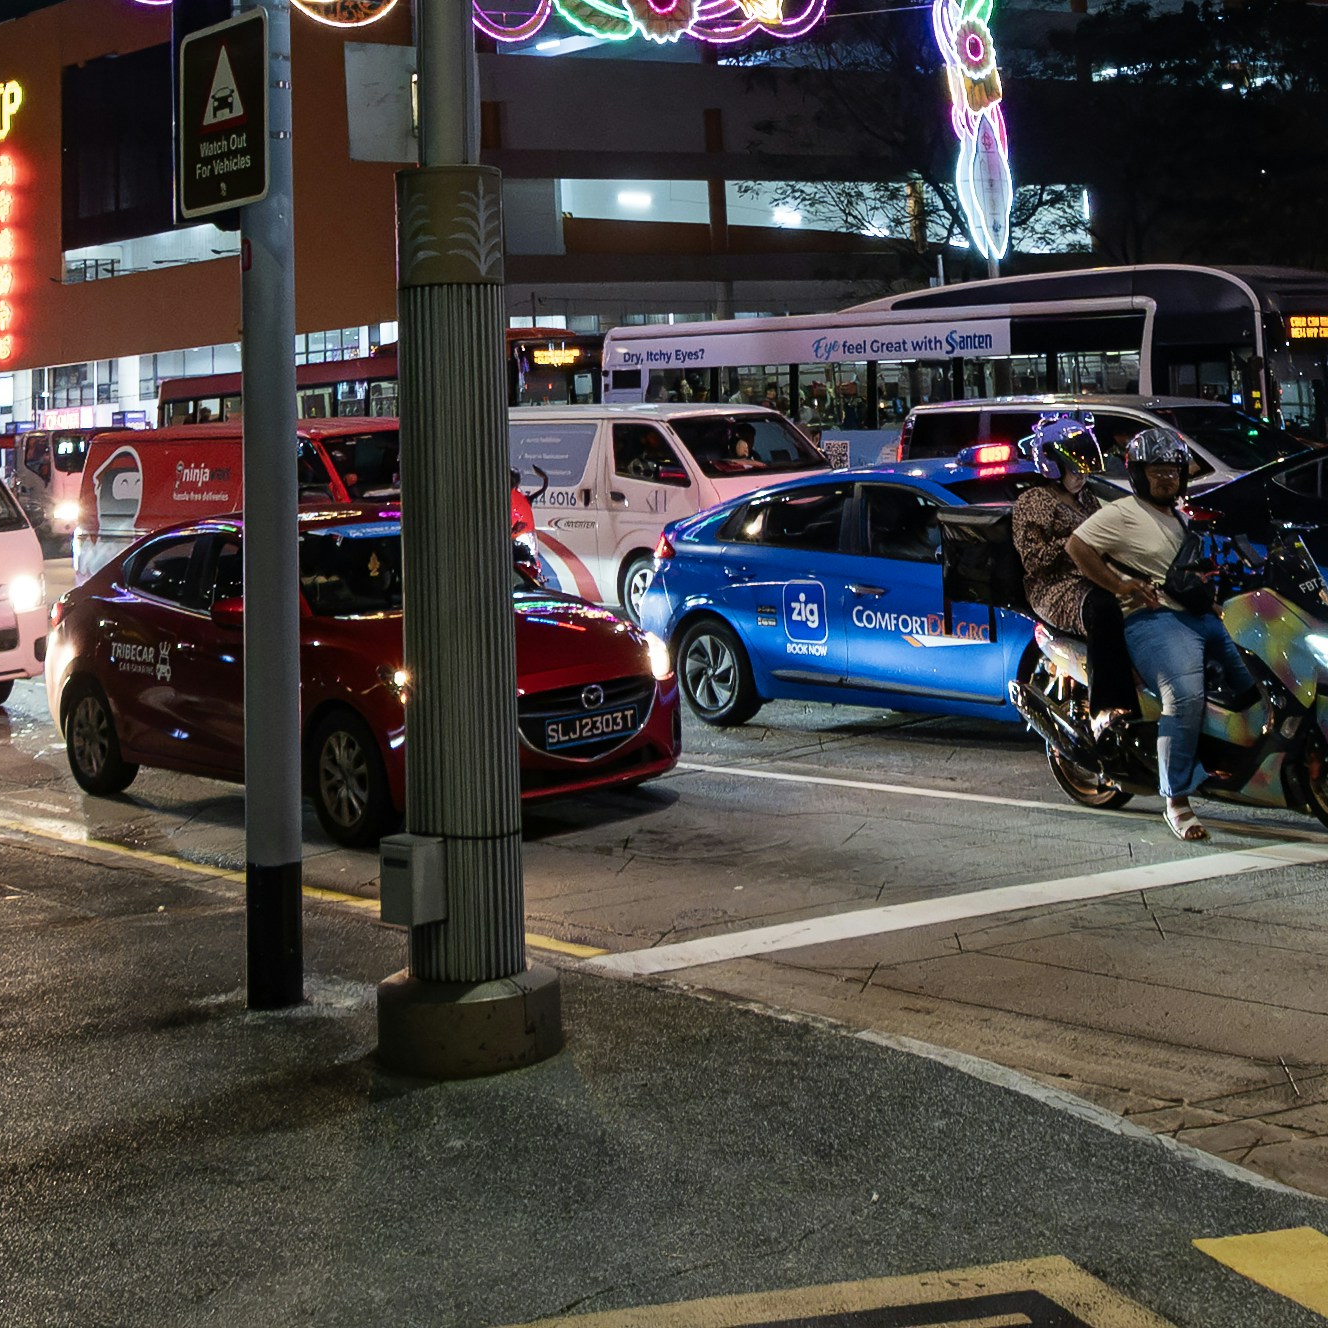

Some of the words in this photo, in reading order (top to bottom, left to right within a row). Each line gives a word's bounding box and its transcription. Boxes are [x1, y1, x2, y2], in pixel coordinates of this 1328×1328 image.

[200, 135, 227, 158] Watch
[230, 132, 247, 150] Out
[196, 163, 211, 179] For
[213, 154, 251, 175] Vehicles
[623, 352, 643, 365] Dry,
[646, 349, 672, 364] Itchy
[675, 348, 705, 363] Eyes?
[812, 336, 840, 360] Eye
[842, 339, 867, 354] feel
[870, 338, 908, 354] Great
[911, 336, 942, 351] with
[946, 330, 992, 355] Santen
[980, 446, 1009, 462] BUSY
[549, 491, 577, 506] 6016
[791, 592, 819, 629] zig
[112, 642, 155, 663] TRIBECAR
[786, 643, 808, 655] BOOK
[809, 644, 828, 657] NOW
[548, 709, 634, 743] SLJ2303T
